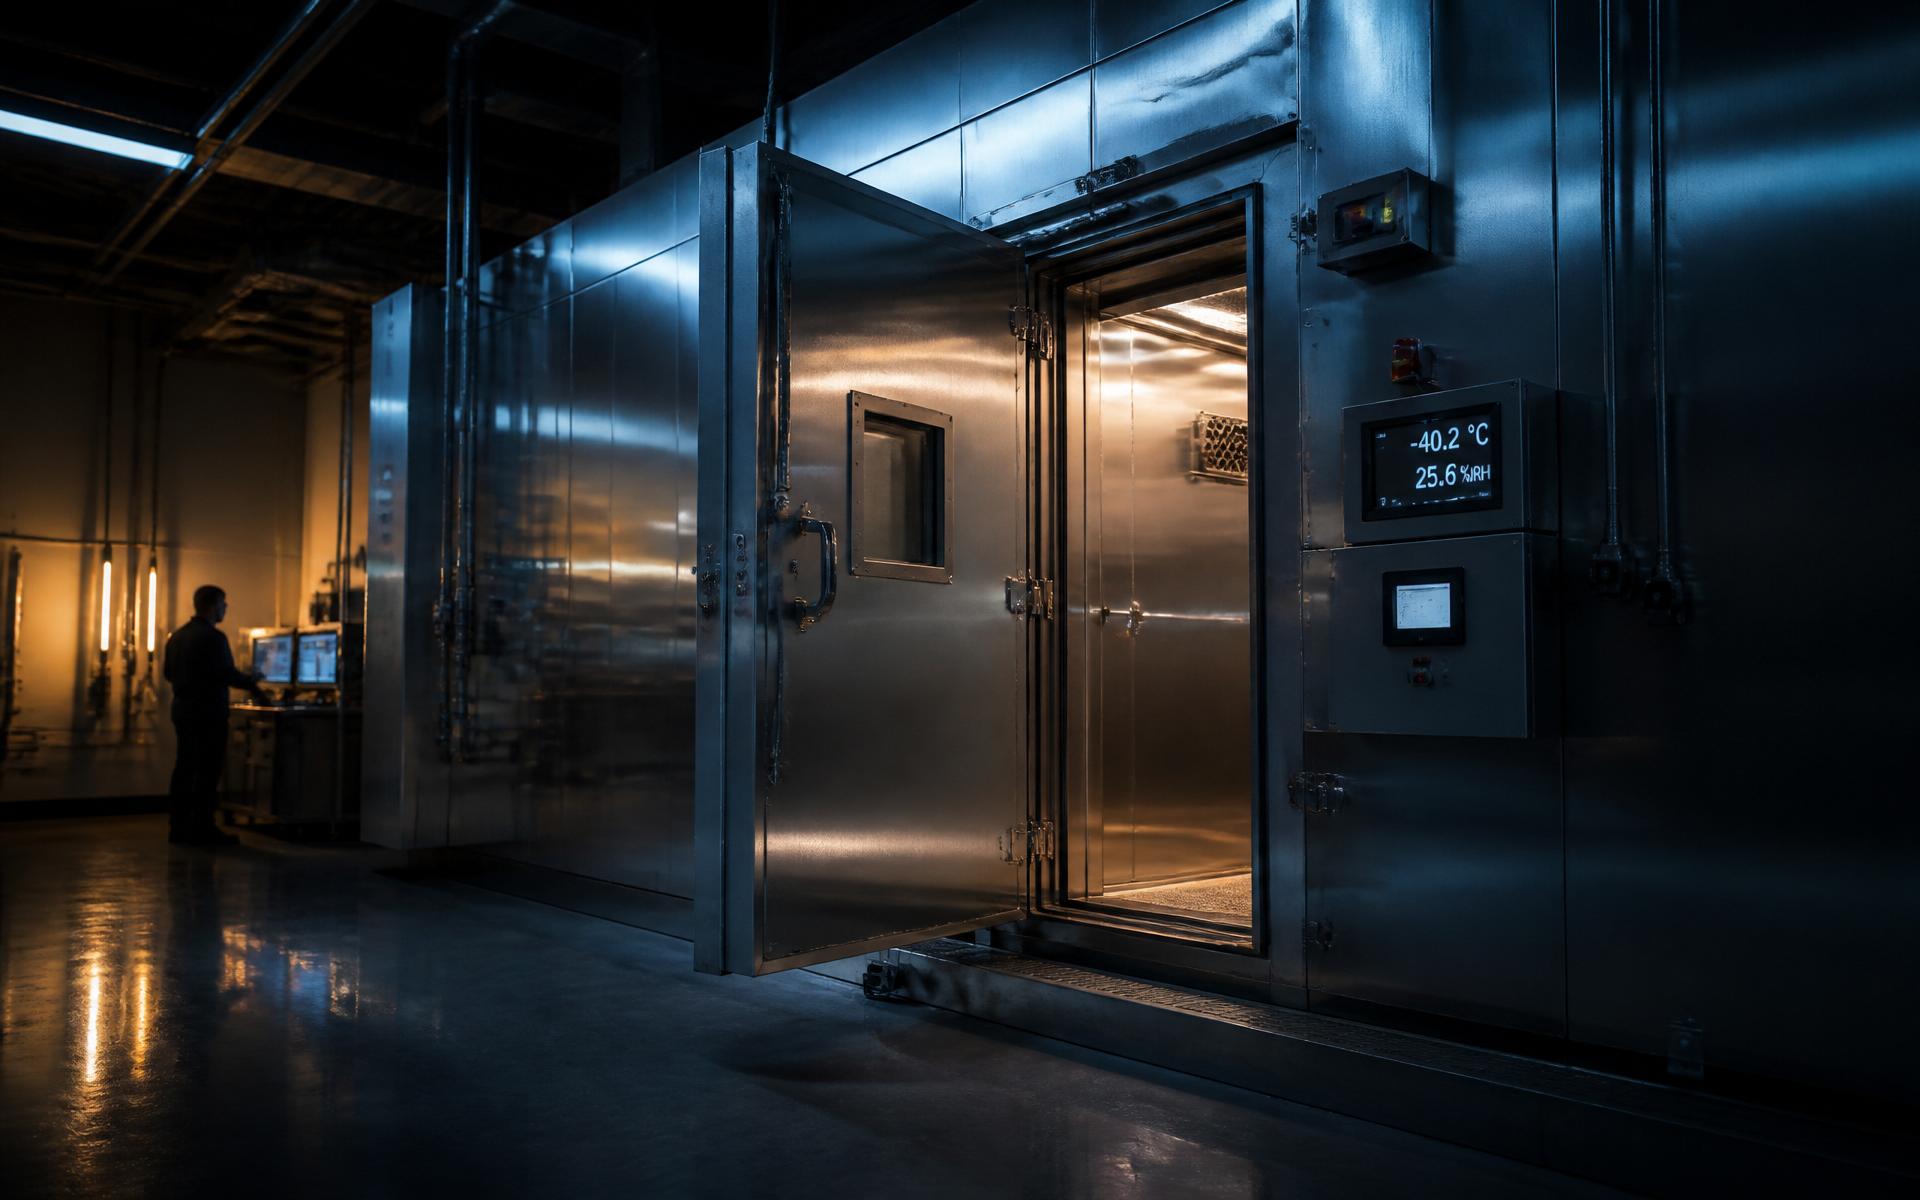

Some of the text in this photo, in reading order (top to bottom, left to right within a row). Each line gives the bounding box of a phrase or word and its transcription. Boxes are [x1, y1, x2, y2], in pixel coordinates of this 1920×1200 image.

[1410, 422, 1489, 453] -40.2 °C
[1415, 463, 1457, 489] 25.6
